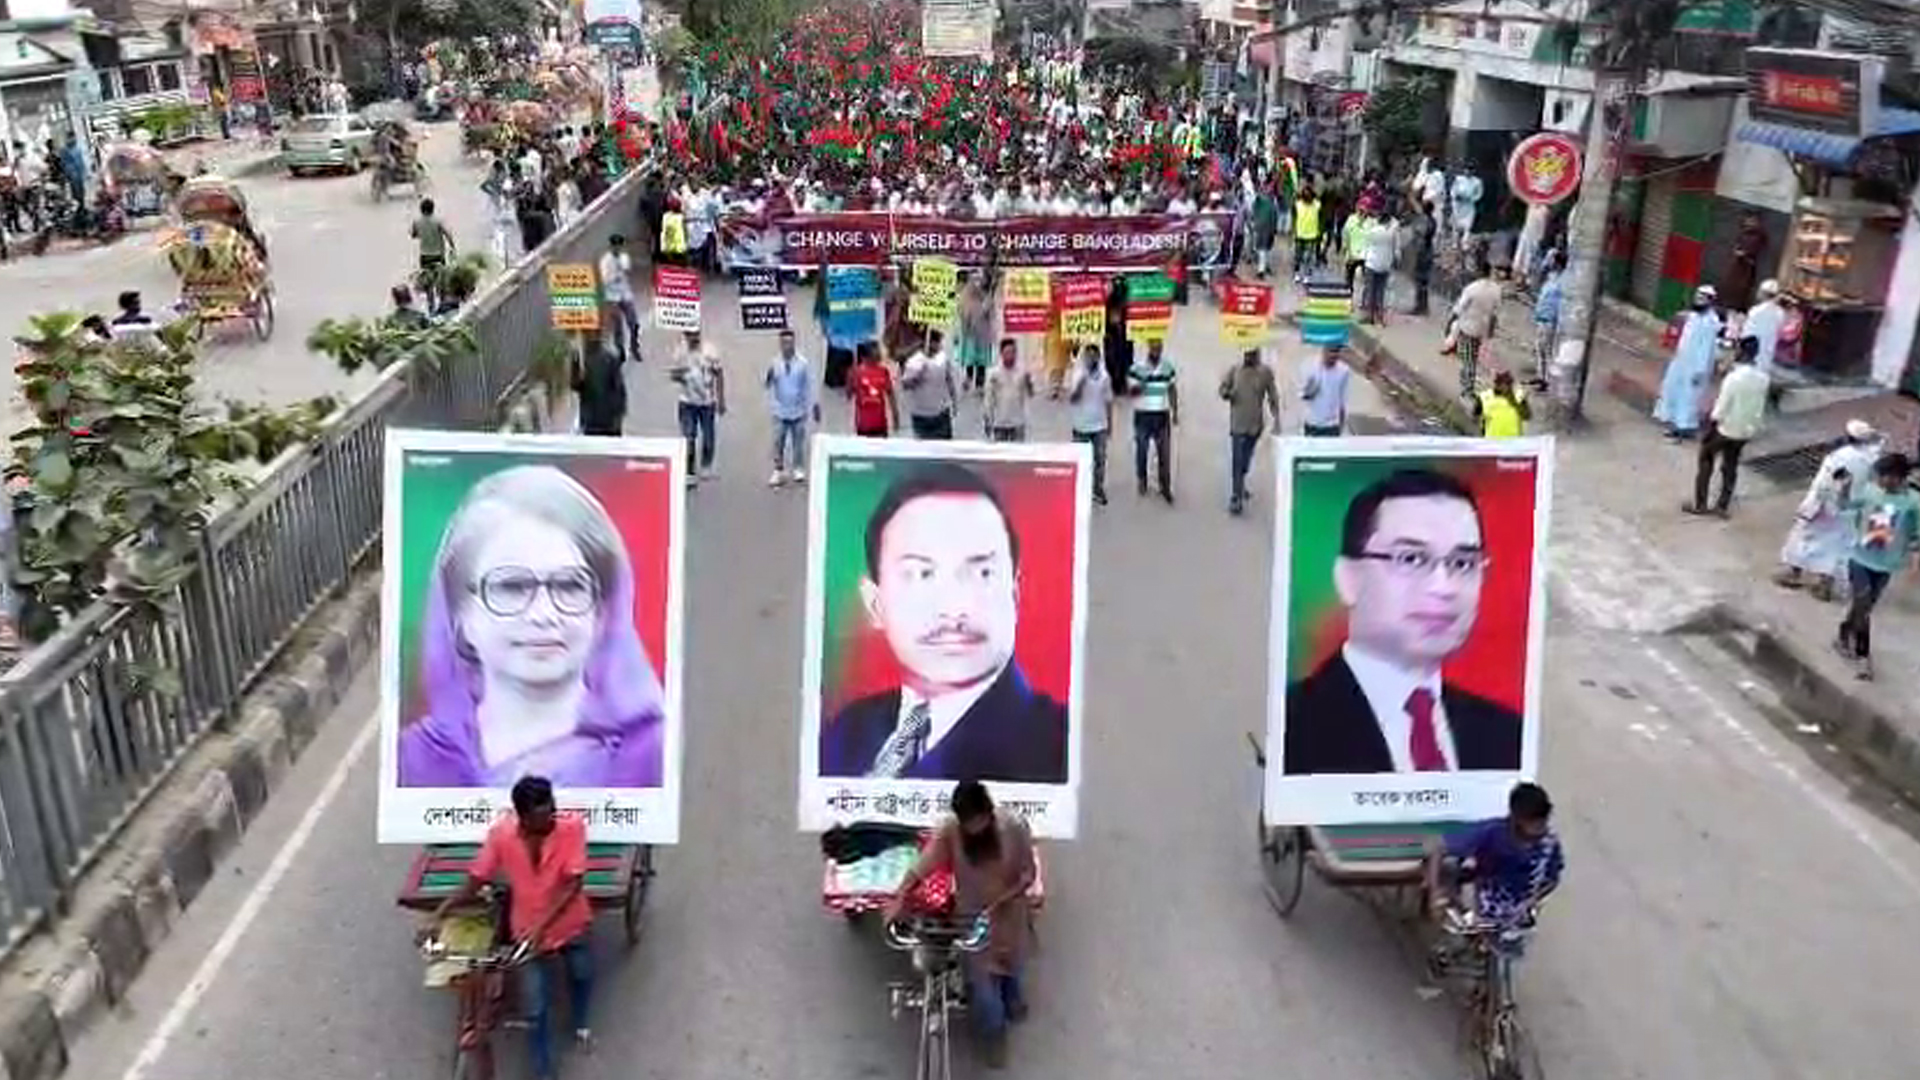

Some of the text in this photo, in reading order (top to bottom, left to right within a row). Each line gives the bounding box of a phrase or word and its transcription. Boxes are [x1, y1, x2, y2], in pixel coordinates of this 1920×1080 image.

[786, 230, 864, 248] CHANGE
[963, 233, 987, 250] TO
[991, 233, 1068, 250] CHANGE
[1072, 233, 1188, 250] BANGLADESH
[1065, 322, 1102, 335] YOU
[603, 800, 640, 826] জিয়া
